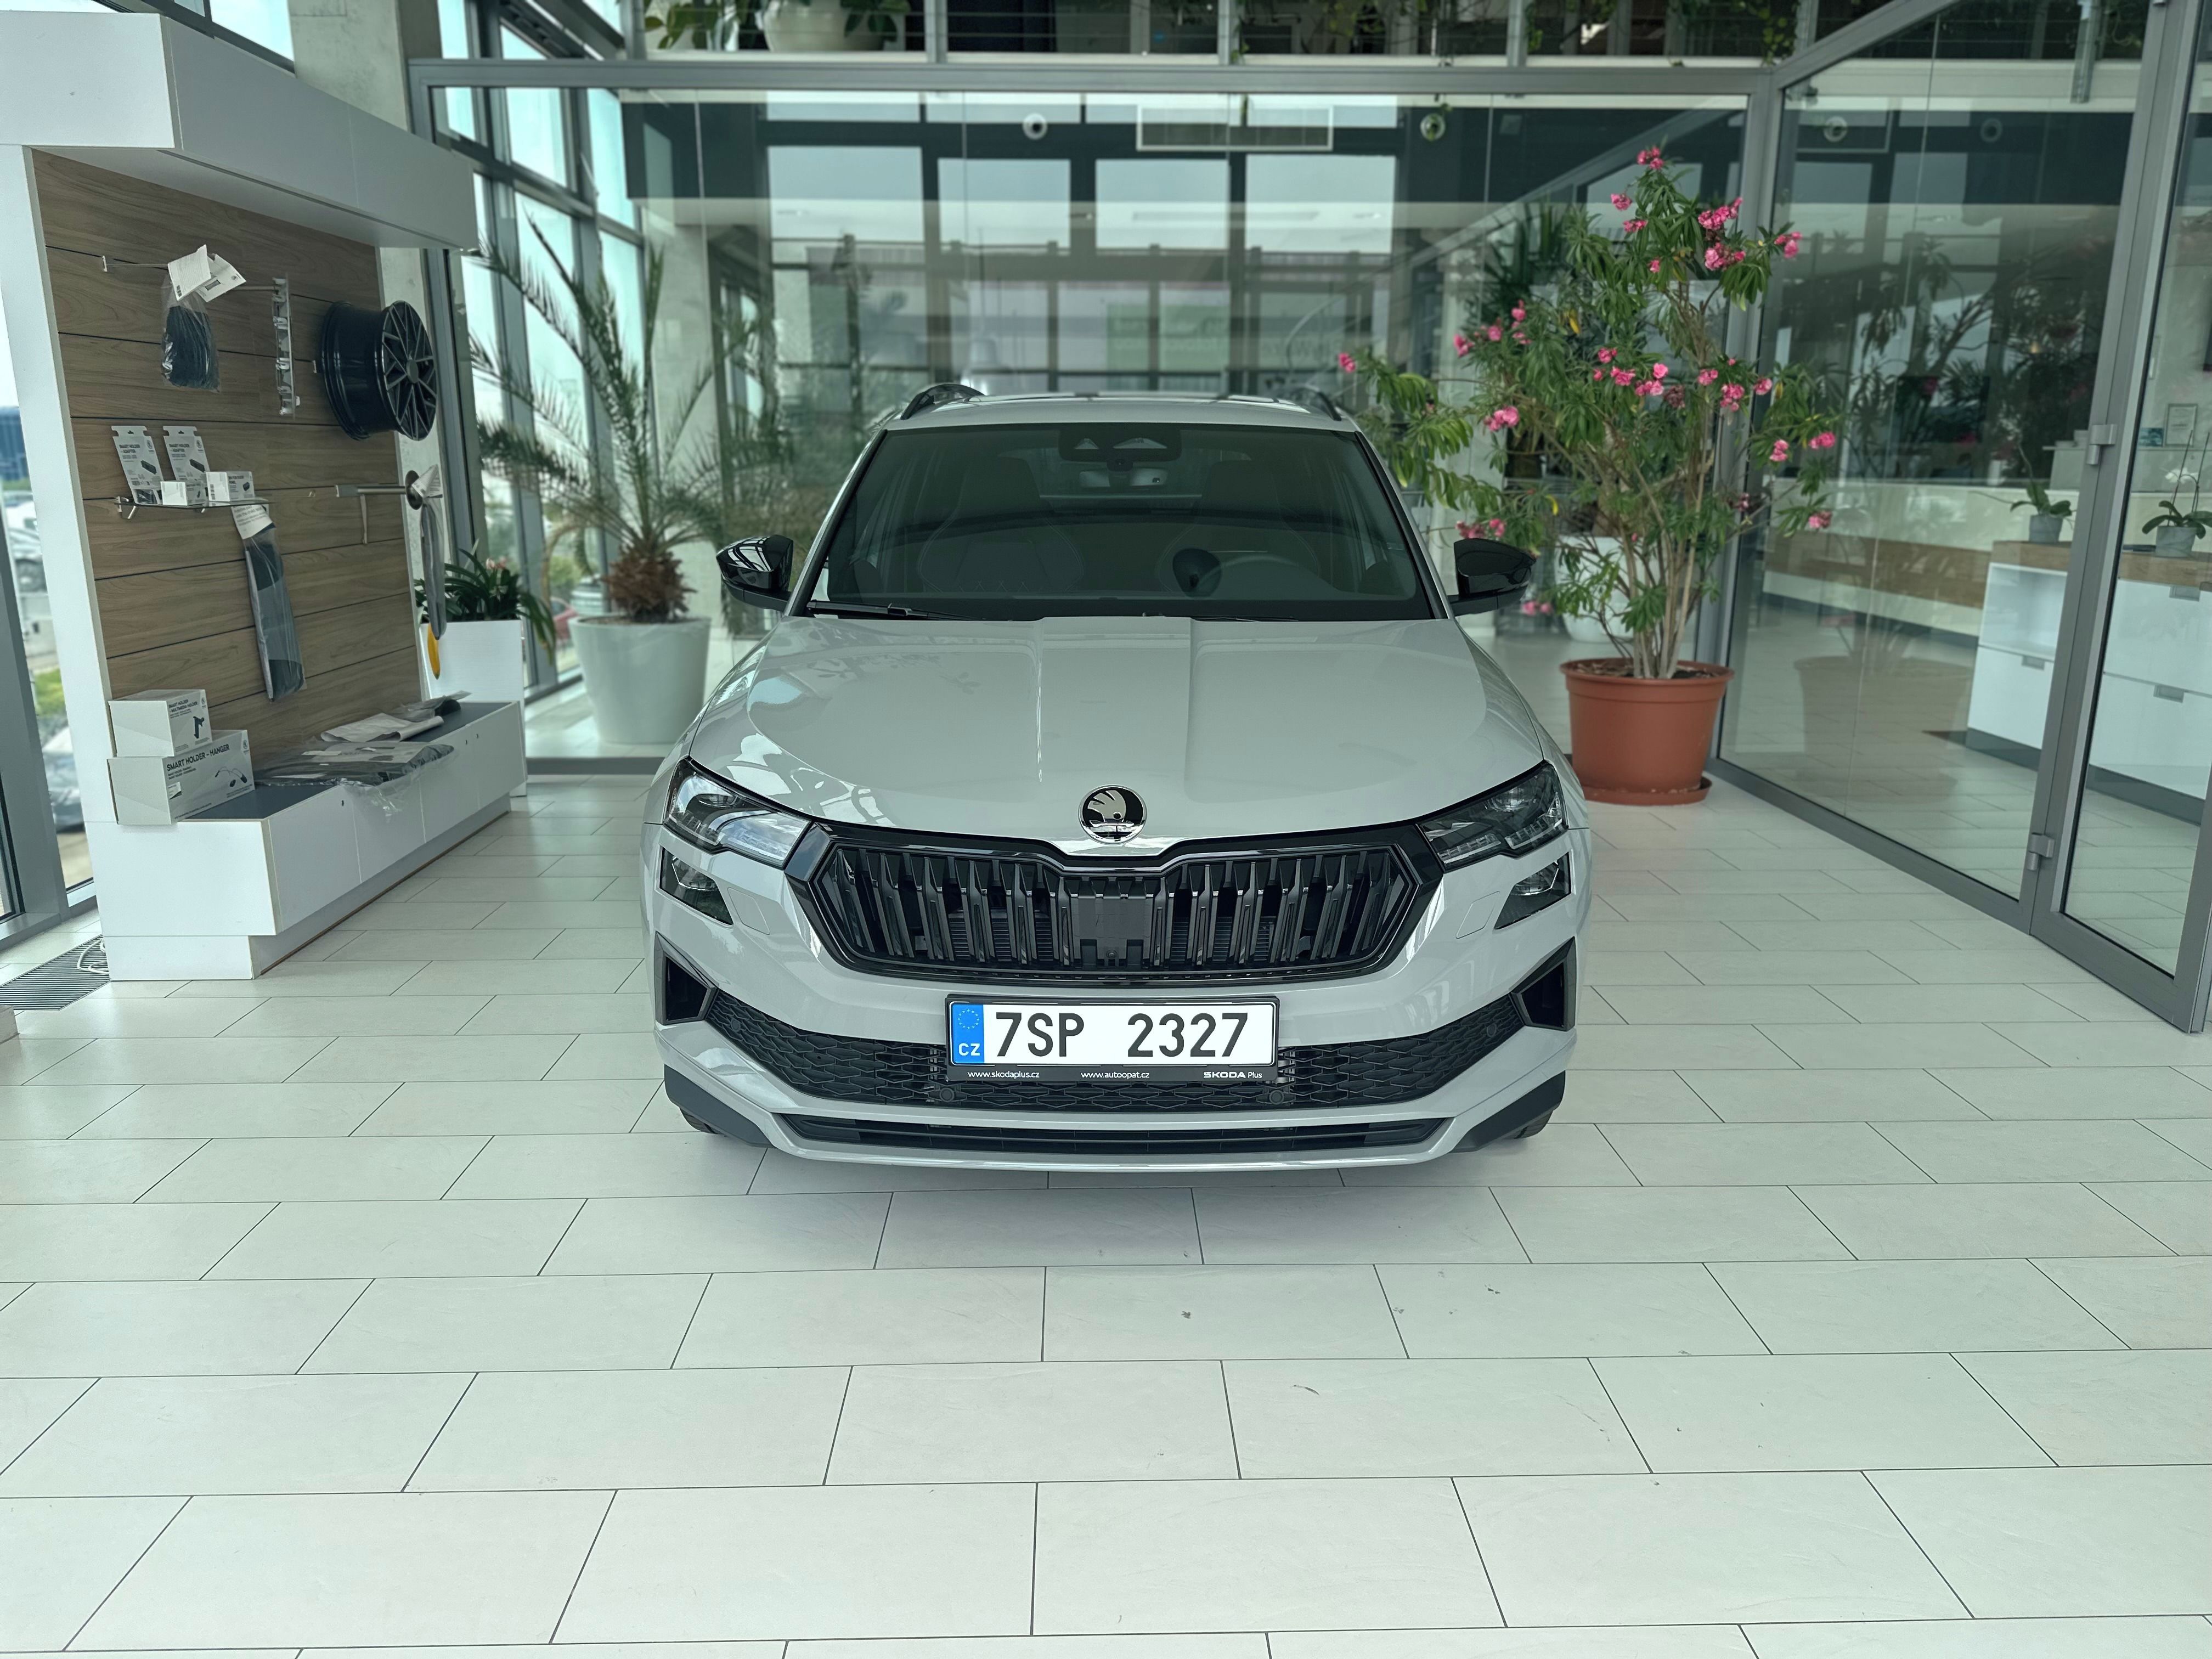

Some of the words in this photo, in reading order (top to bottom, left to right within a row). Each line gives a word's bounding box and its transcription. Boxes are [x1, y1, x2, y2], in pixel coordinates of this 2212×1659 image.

[167, 759, 185, 771] SMART
[185, 752, 206, 765] HOLDER
[210, 744, 230, 757] HANGER
[996, 1012, 1085, 1057] 7SP
[1127, 1012, 1248, 1057] 2327
[958, 1043, 980, 1056] CZ
[967, 1070, 1040, 1079] www.skodaplus.cz
[1080, 1071, 1150, 1080] www.autoopat.cz
